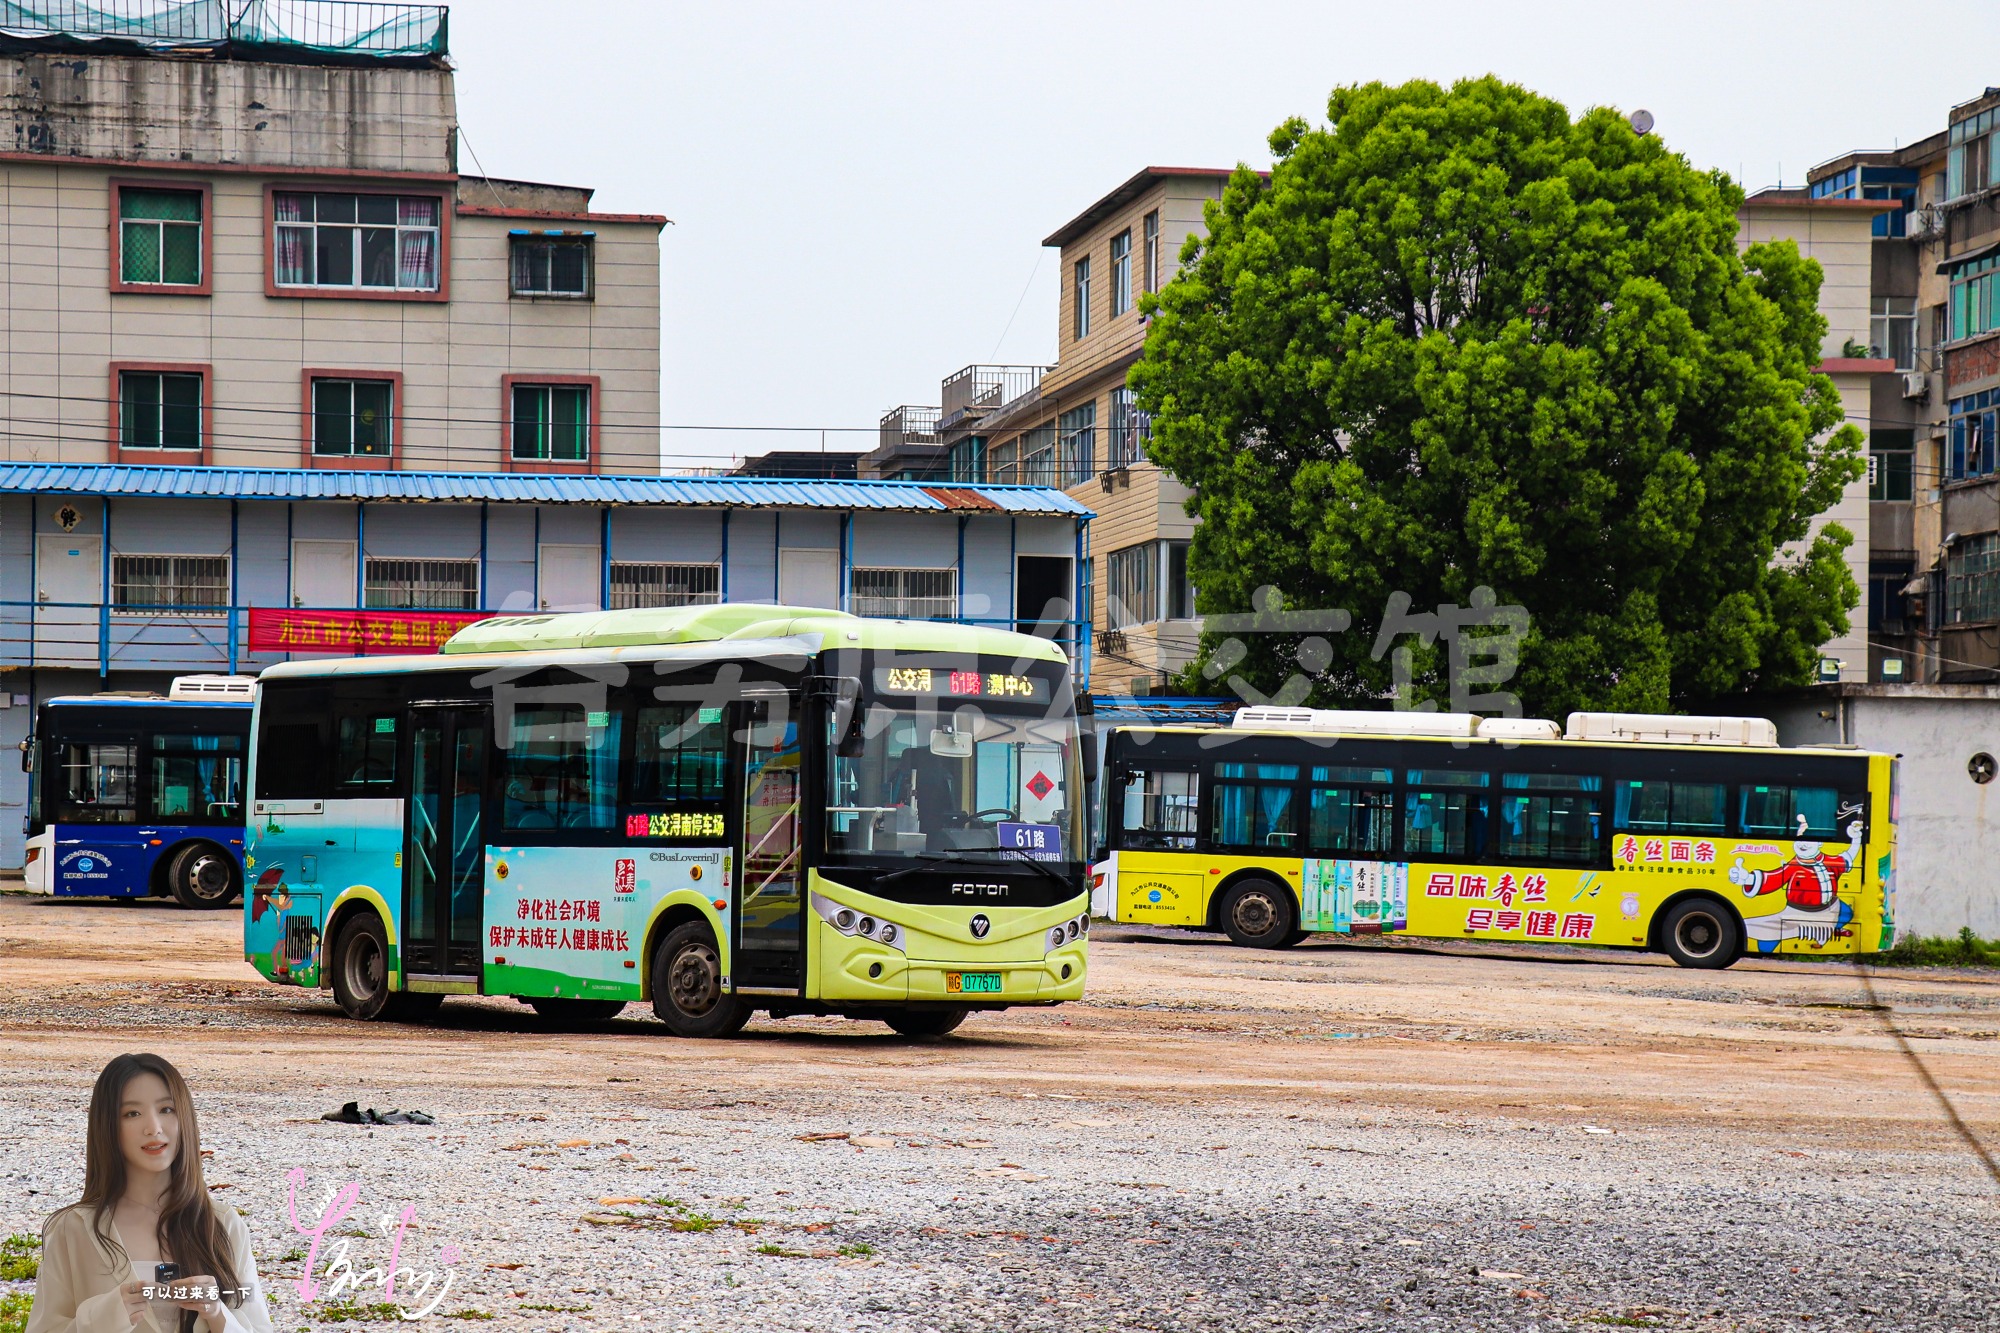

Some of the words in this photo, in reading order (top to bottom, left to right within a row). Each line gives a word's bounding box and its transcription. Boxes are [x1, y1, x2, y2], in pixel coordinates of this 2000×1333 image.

[951, 672, 980, 695] 61路
[1015, 829, 1045, 849] 61路
[1616, 836, 1716, 862] 春丝面条
[951, 883, 1009, 896] FOTON
[1426, 873, 1549, 907] 品味春丝
[517, 899, 601, 922] 净化社会环境
[1466, 908, 1596, 939] 尽享健康
[489, 926, 630, 951] 保护未成年人健康成长
